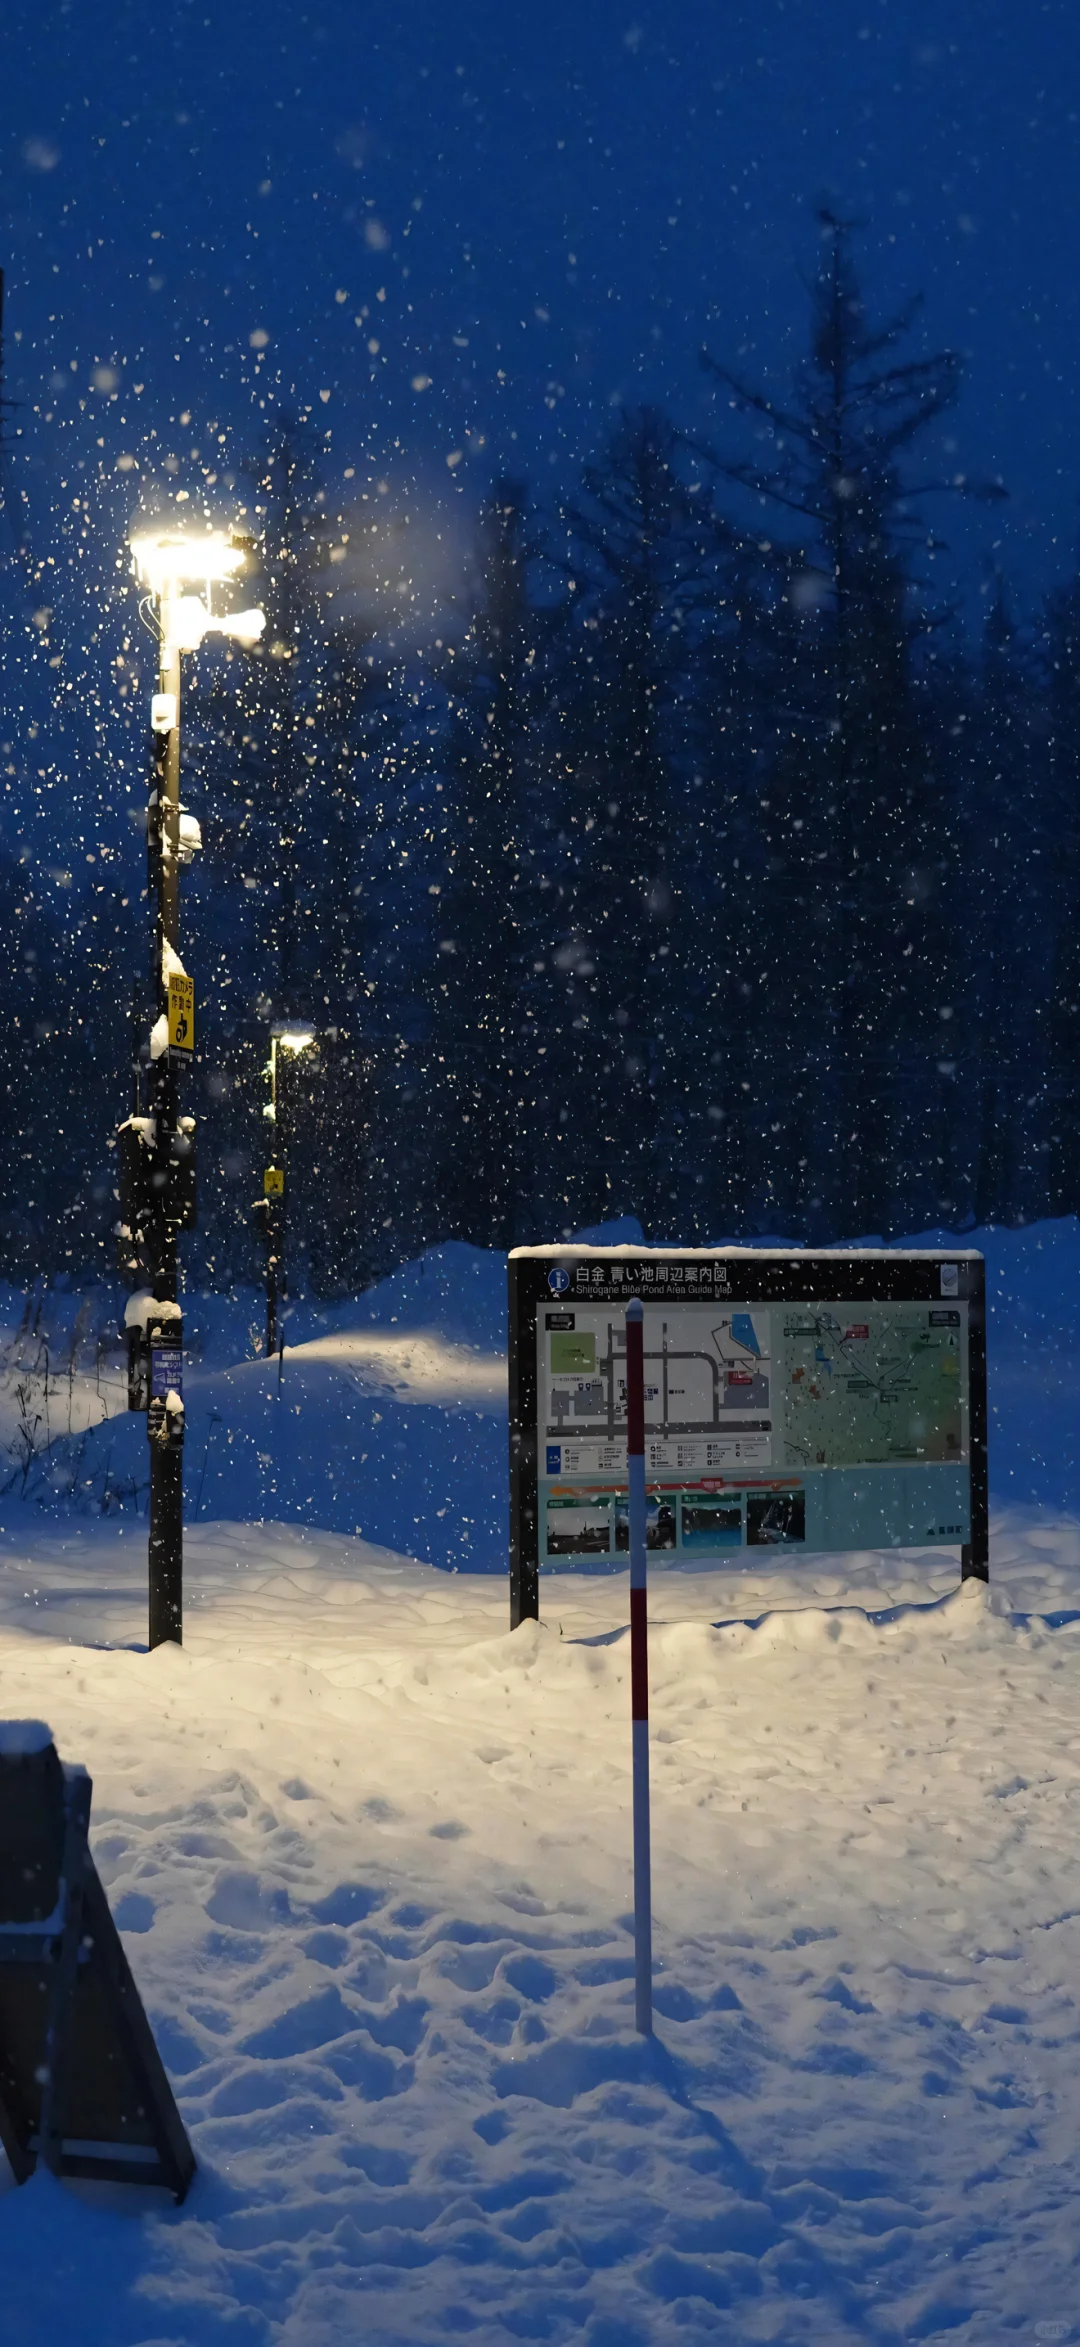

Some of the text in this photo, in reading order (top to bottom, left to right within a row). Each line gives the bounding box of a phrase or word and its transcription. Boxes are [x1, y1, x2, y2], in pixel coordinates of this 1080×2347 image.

[576, 1266, 727, 1282] 白金 青い池周辺案内図
[576, 1284, 733, 1296] Shirogane Blue Pond Area Guide Map
